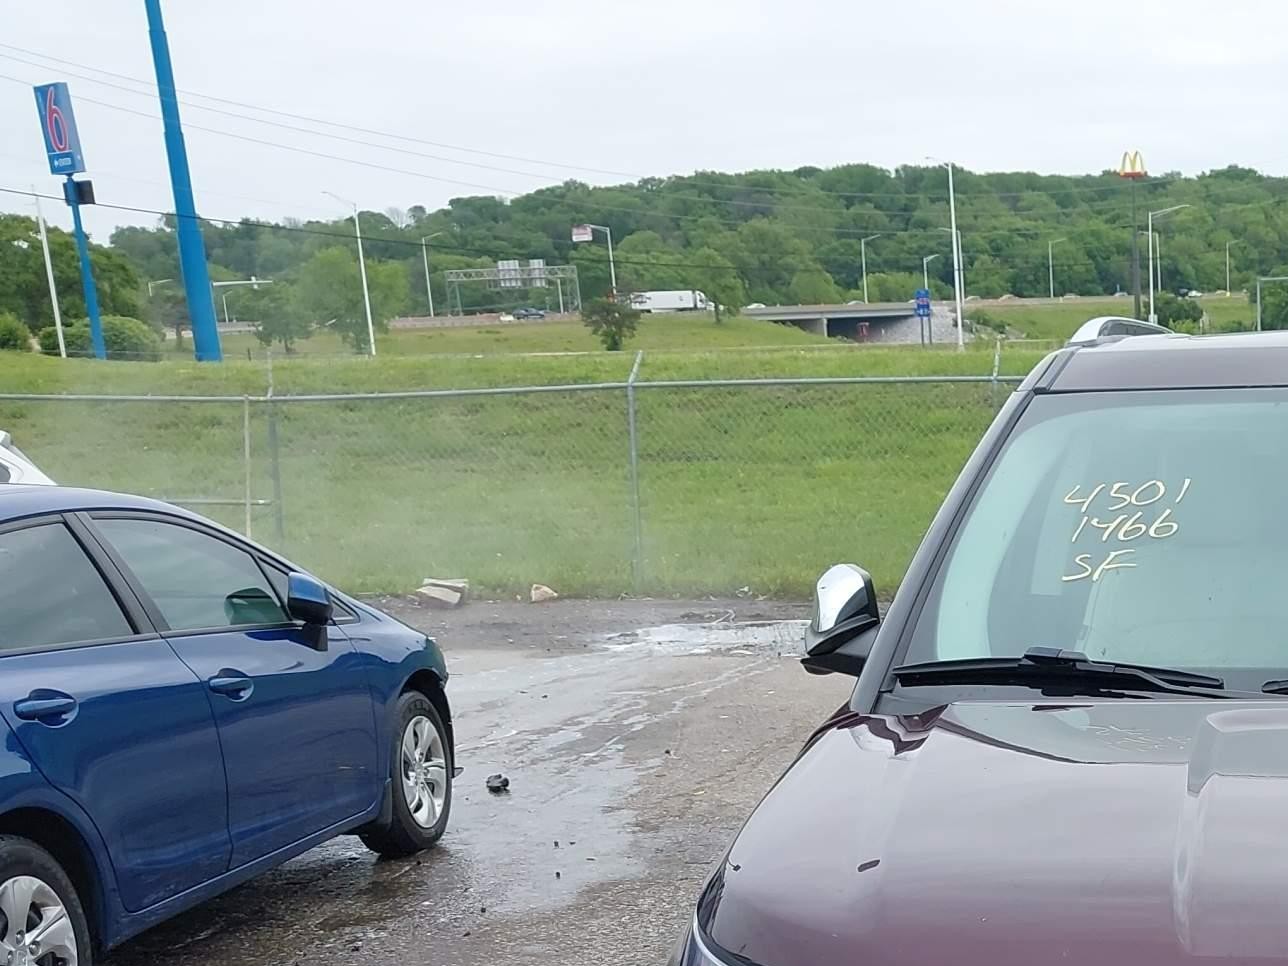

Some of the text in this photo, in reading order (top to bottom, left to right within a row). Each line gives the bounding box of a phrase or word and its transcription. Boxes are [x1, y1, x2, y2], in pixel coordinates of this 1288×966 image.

[46, 86, 69, 152] 6
[1063, 478, 1191, 513] 4501
[1071, 508, 1178, 543] 1466
[1061, 549, 1137, 581] SF
